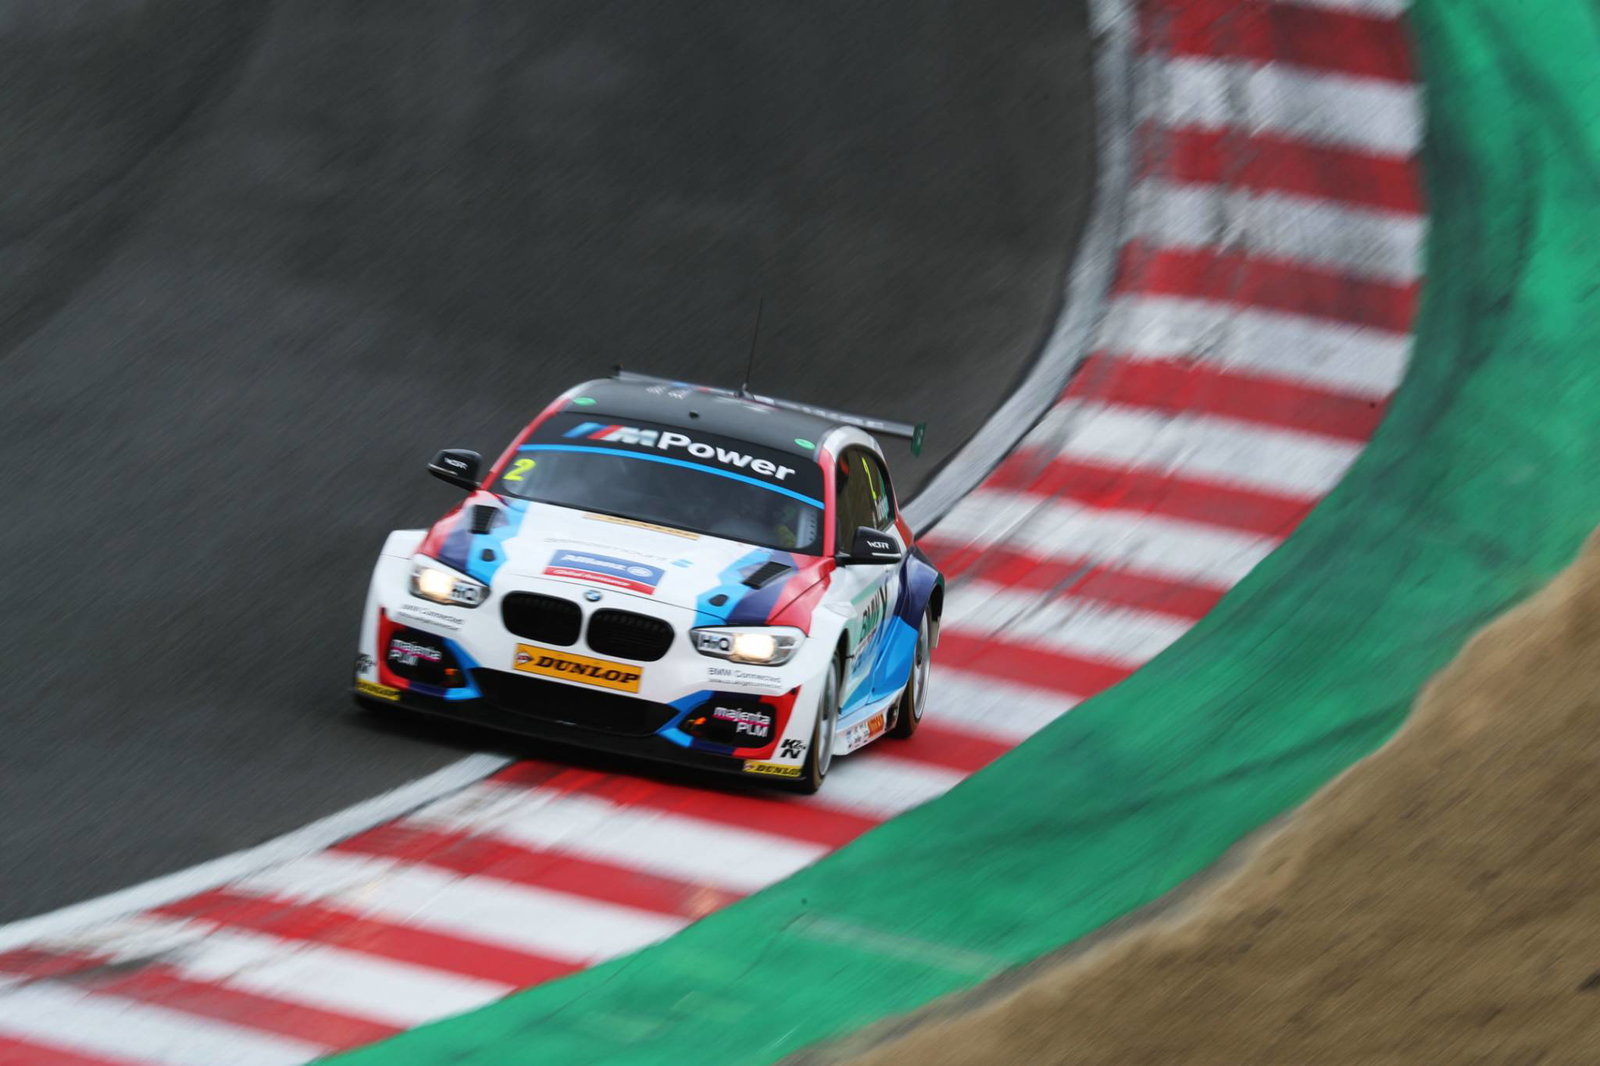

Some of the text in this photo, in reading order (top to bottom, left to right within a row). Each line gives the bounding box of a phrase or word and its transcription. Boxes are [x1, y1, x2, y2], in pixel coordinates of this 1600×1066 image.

[503, 458, 536, 481] 2
[534, 656, 640, 683] DUNLOP
[713, 706, 771, 724] majenta
[735, 722, 769, 738] PLM
